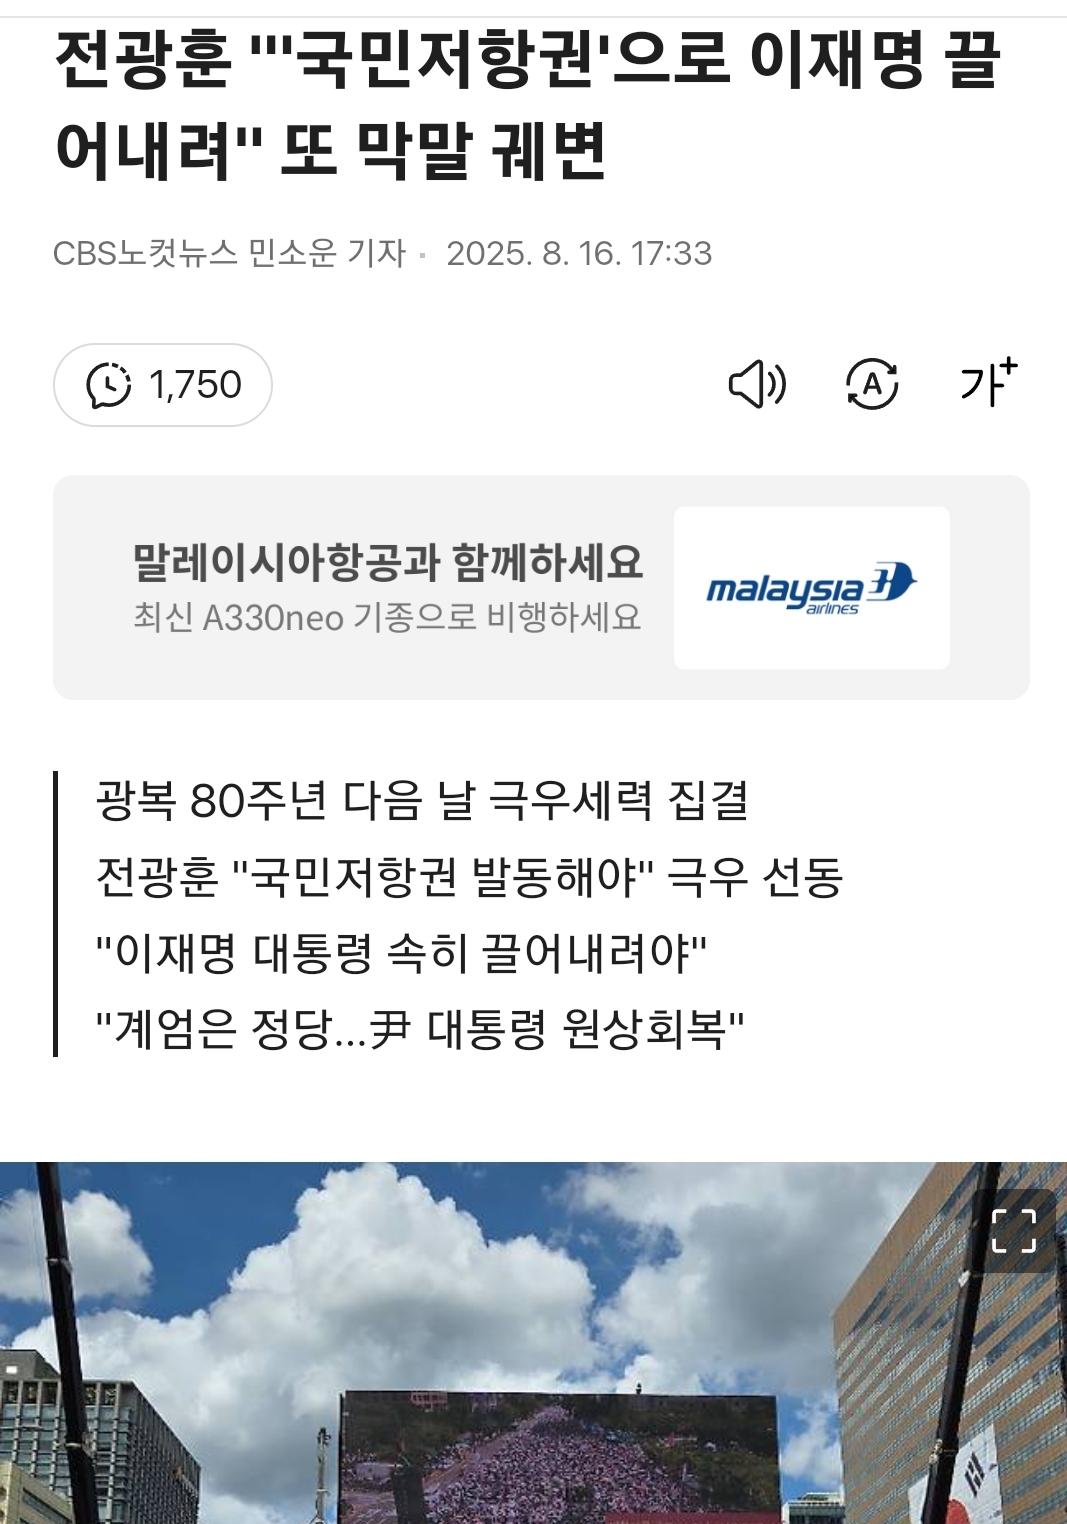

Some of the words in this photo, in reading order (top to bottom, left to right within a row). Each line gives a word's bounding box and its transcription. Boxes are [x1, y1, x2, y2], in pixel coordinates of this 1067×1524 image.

[56, 28, 231, 90] 전광훈
[251, 29, 730, 89] "'국민저항권'으로
[752, 30, 922, 89] 이재명
[945, 31, 1000, 88] 끌
[57, 122, 261, 181] 어내려"
[281, 125, 337, 174] 또
[359, 122, 473, 181] 막말
[492, 122, 604, 181] 궤변
[54, 239, 237, 268] CBS노컷뉴스
[251, 239, 336, 267] 민소운
[349, 239, 406, 268] 기자
[448, 241, 531, 265] 2025.
[543, 241, 568, 265] 8.
[580, 241, 620, 265] 16.
[632, 241, 711, 265] 17:33
[151, 370, 241, 403] 1,750
[135, 543, 441, 582] 말레이시아항공과
[453, 543, 643, 582] 함께하세요
[706, 574, 865, 610] malaysia
[806, 603, 860, 615] airlines
[135, 602, 191, 633] 최신
[203, 604, 343, 631] A330neo
[355, 602, 476, 633] 기종으로
[489, 602, 640, 633] 비행하세요
[97, 780, 176, 821] 광복
[191, 780, 325, 821] 80주년
[345, 780, 422, 821] 다음
[440, 781, 476, 820] 날
[490, 781, 650, 821] 극우세력
[669, 780, 746, 820] 집결
[97, 857, 218, 898] 전광훈
[234, 857, 455, 898] "국민저항권
[474, 857, 652, 898] 발동해야"
[668, 858, 748, 898] 극우
[763, 857, 843, 898] 선동
[97, 933, 233, 974] "이재명
[255, 933, 370, 974] 대통령
[388, 933, 465, 974] 속히
[482, 934, 705, 974] 끌어내려야"
[97, 1009, 236, 1050] "계엄은
[252, 1009, 411, 1050] 정당...尹
[429, 1010, 544, 1050] 대통령
[563, 1009, 743, 1050] 원상회복"
